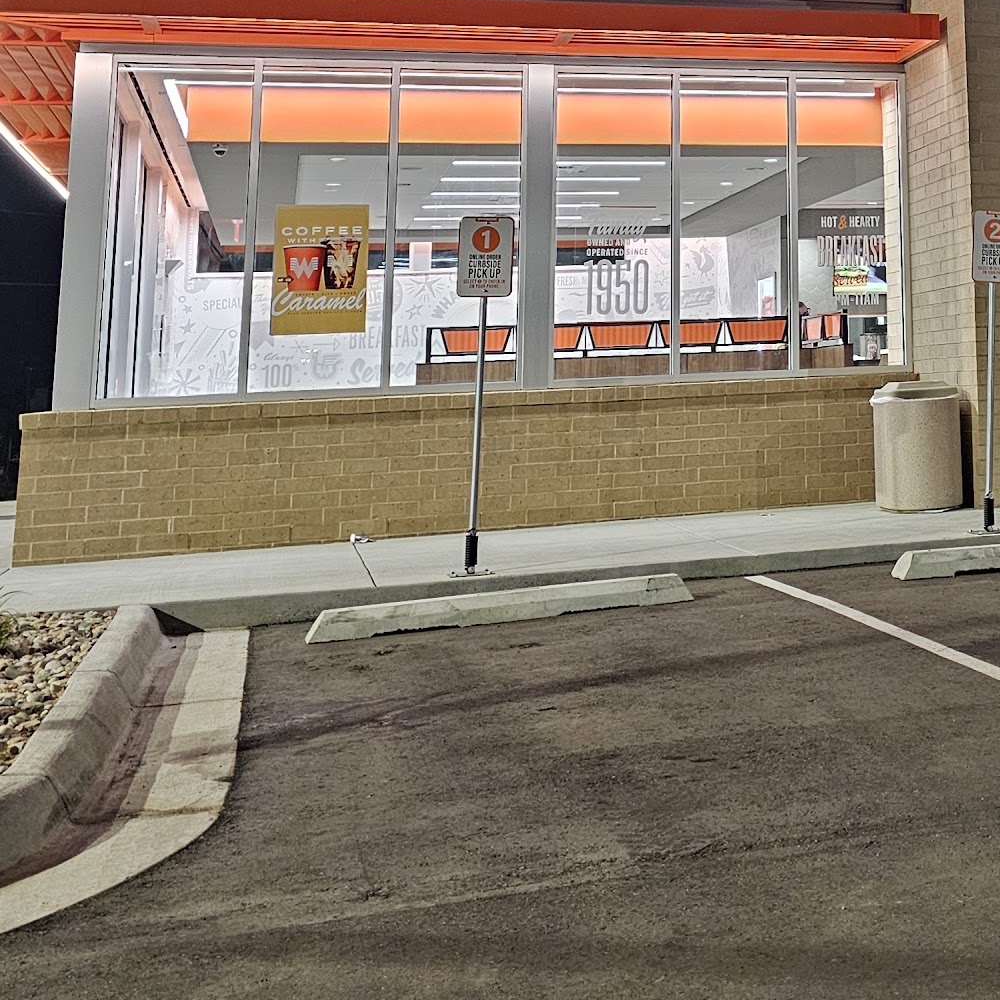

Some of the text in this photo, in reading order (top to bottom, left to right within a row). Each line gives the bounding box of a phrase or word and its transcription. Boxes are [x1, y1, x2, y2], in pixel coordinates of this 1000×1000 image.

[820, 215, 880, 230] HOT & HEARTY
[281, 226, 363, 236] COFFEE
[989, 222, 1000, 239] 2
[482, 229, 491, 249] 1
[586, 238, 631, 246] OWNED AND
[586, 248, 649, 256] OPERATED SINCE
[816, 235, 885, 268] BREAKFAST
[468, 260, 502, 268] CURBSIDE
[981, 257, 998, 266] PICK
[468, 268, 502, 278] PICK UP
[584, 259, 650, 315] 1950
[271, 287, 367, 317] Caramel
[350, 325, 427, 350] BREAFAST
